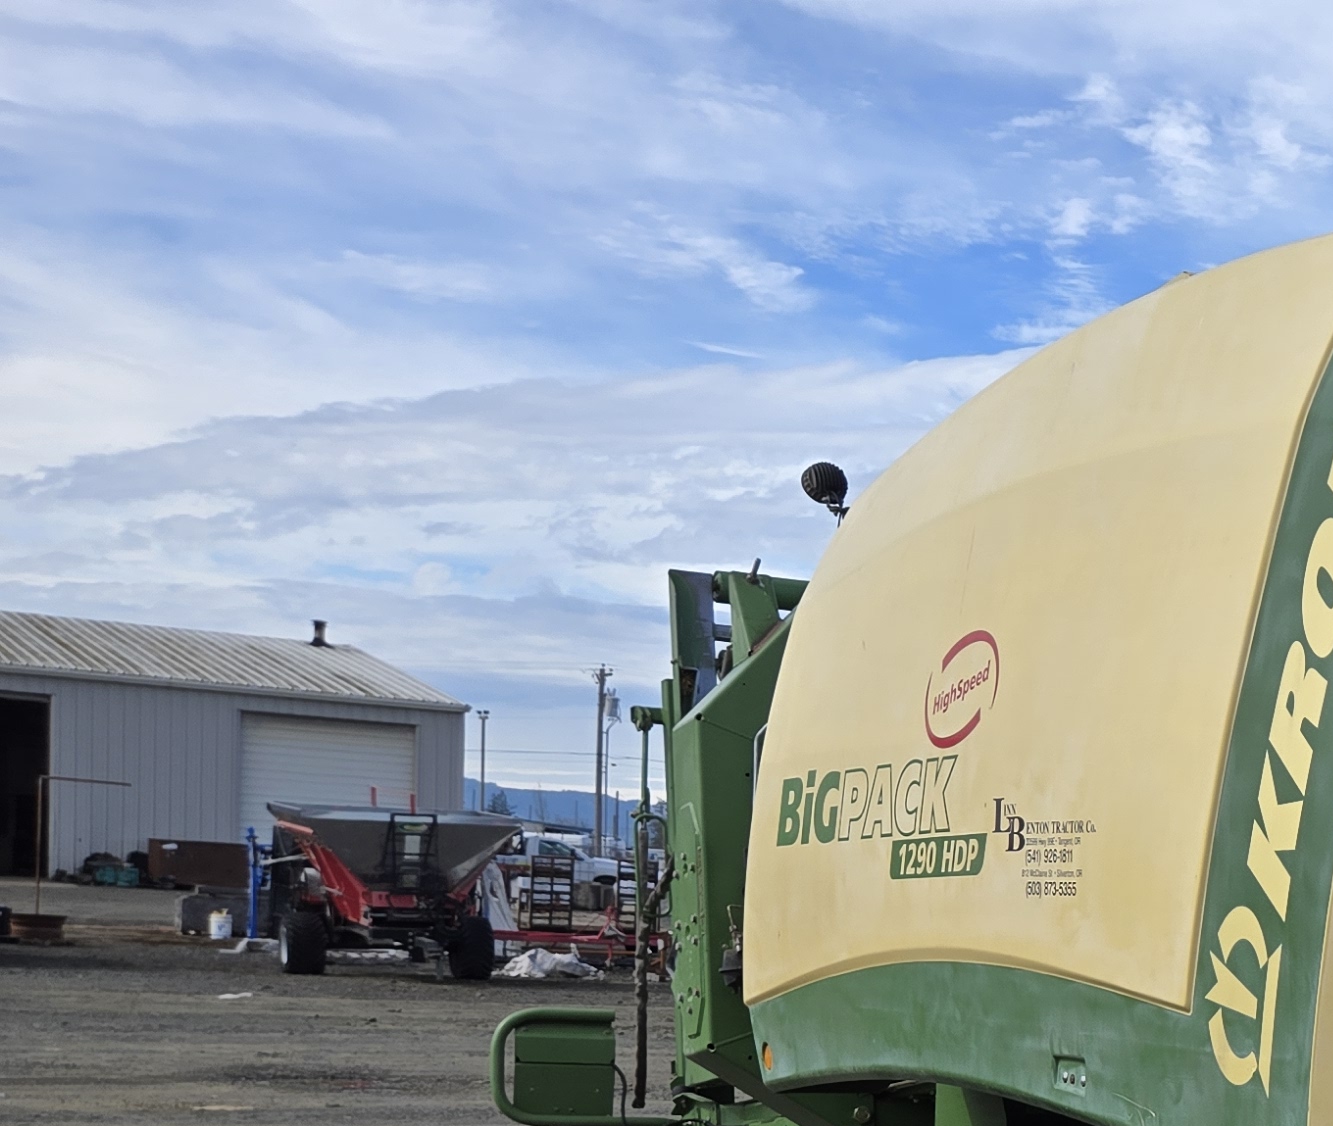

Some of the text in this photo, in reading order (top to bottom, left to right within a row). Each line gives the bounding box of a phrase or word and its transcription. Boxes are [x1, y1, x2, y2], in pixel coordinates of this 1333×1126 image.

[932, 659, 991, 715] HighSpeed
[1051, 820, 1084, 834] TRACTOR
[898, 838, 979, 875] 1290 HDP
[1025, 848, 1073, 866] (541) 926-1811
[1025, 881, 1077, 898] (503) 873-5355
